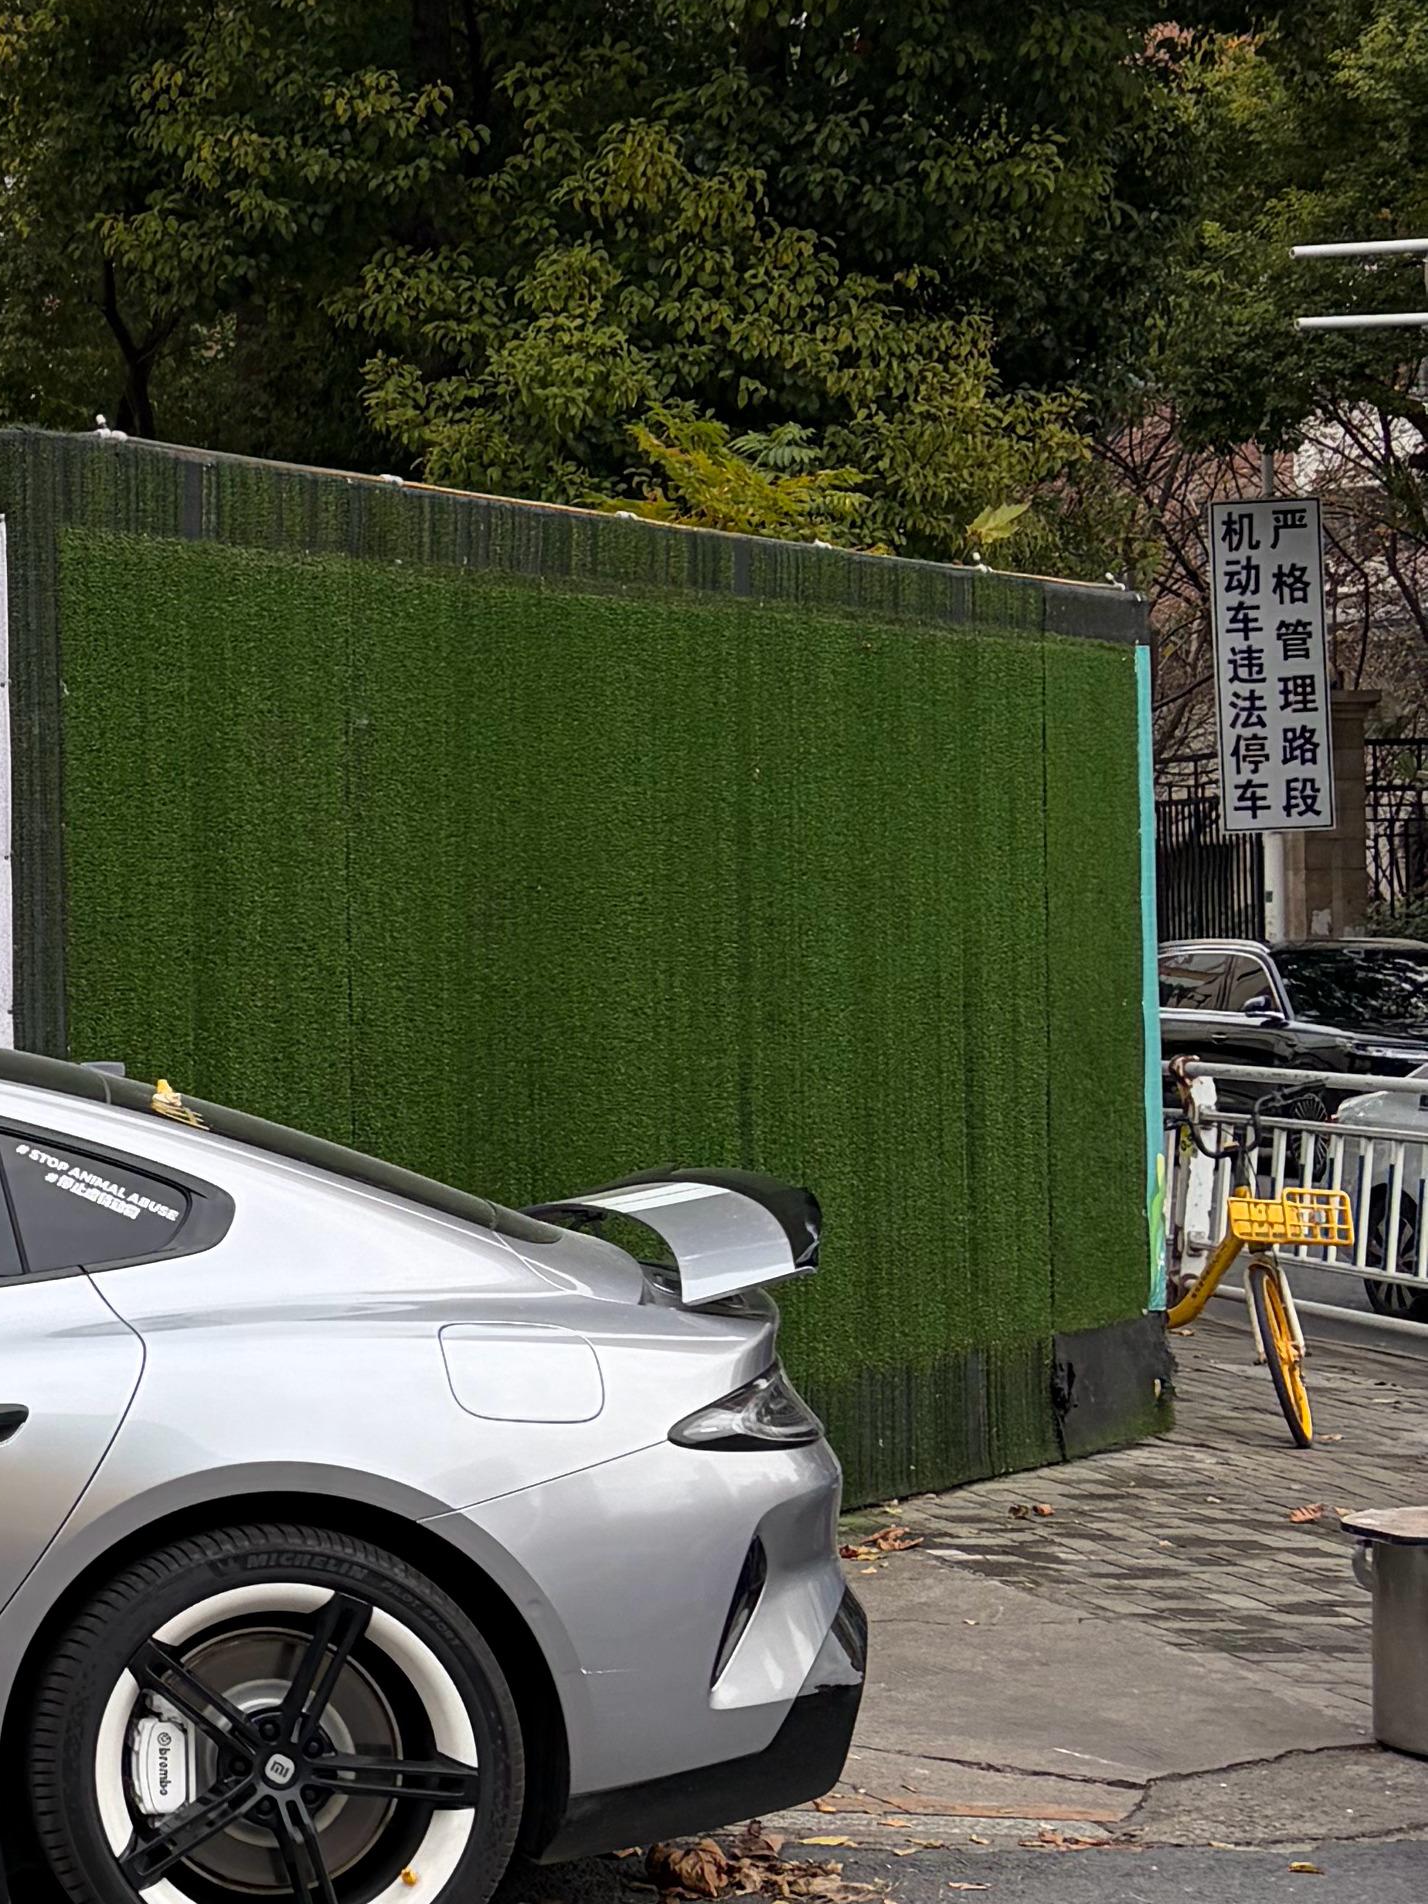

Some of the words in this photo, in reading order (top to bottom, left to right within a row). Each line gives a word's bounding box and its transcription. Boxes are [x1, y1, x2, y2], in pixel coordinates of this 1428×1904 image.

[1220, 511, 1271, 820] 机动车违法停车
[1270, 507, 1323, 819] 严格管理路段
[67, 1166, 127, 1200] ANIMAL
[125, 1192, 181, 1222] ABUSE
[246, 1551, 369, 1582] MICHELIN
[158, 1747, 172, 1796] brembo
